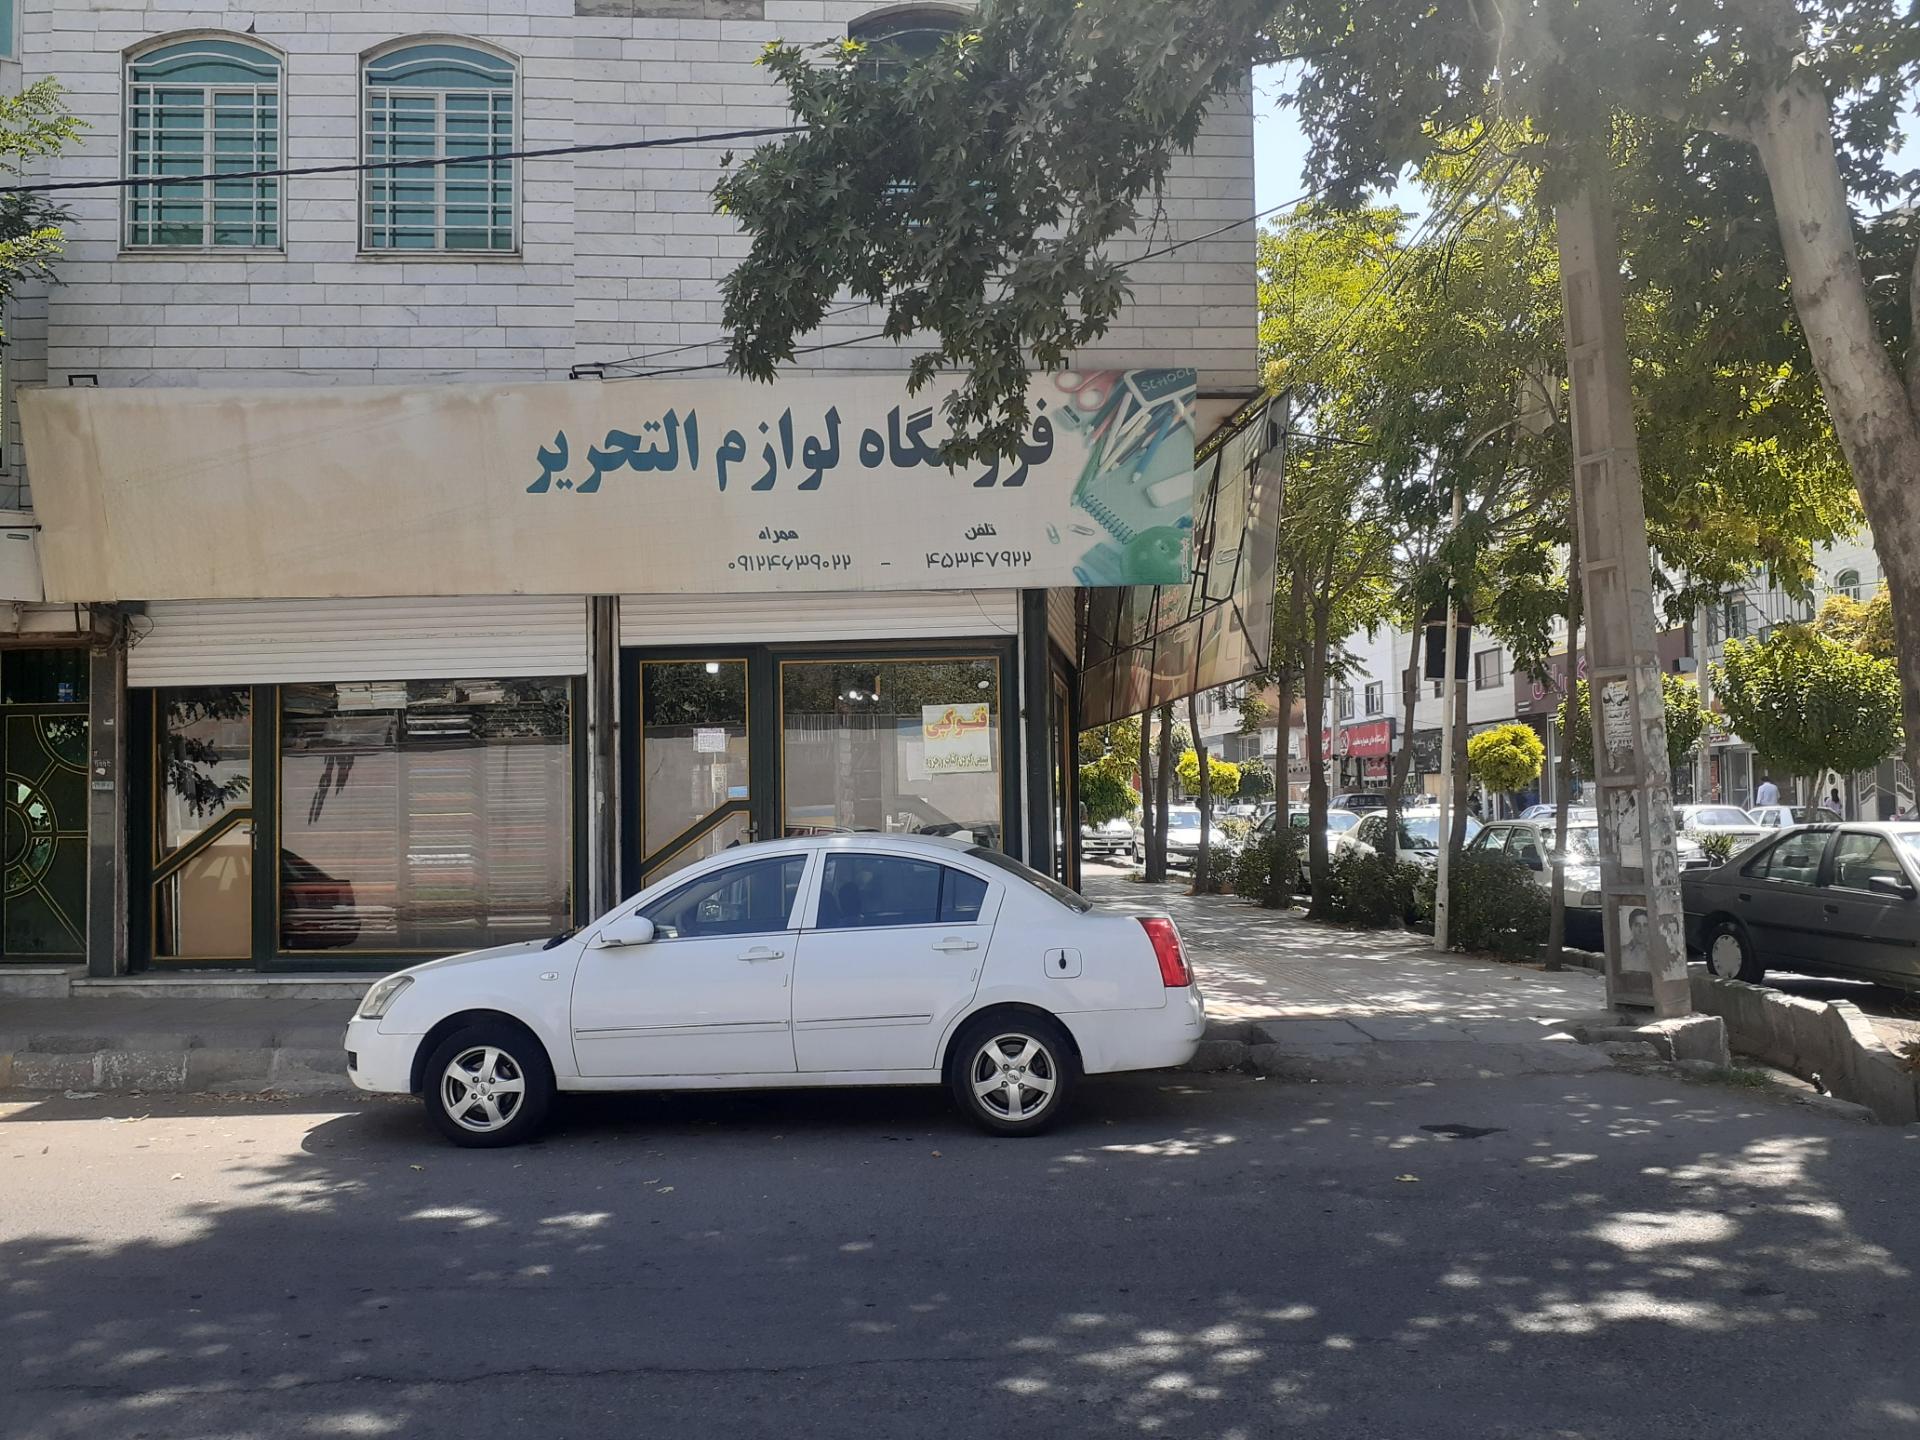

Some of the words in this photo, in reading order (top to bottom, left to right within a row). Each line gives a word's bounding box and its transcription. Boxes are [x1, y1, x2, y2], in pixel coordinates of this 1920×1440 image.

[525, 407, 700, 493] التحریر
[715, 405, 843, 492] لوازم
[758, 525, 800, 544] همراه
[964, 522, 998, 541] تلفن
[727, 553, 852, 572] ۰۹۱۲۴۶۳۹۰۲۲
[925, 550, 1033, 569] ۴۵۳۴۷۹۲۲
